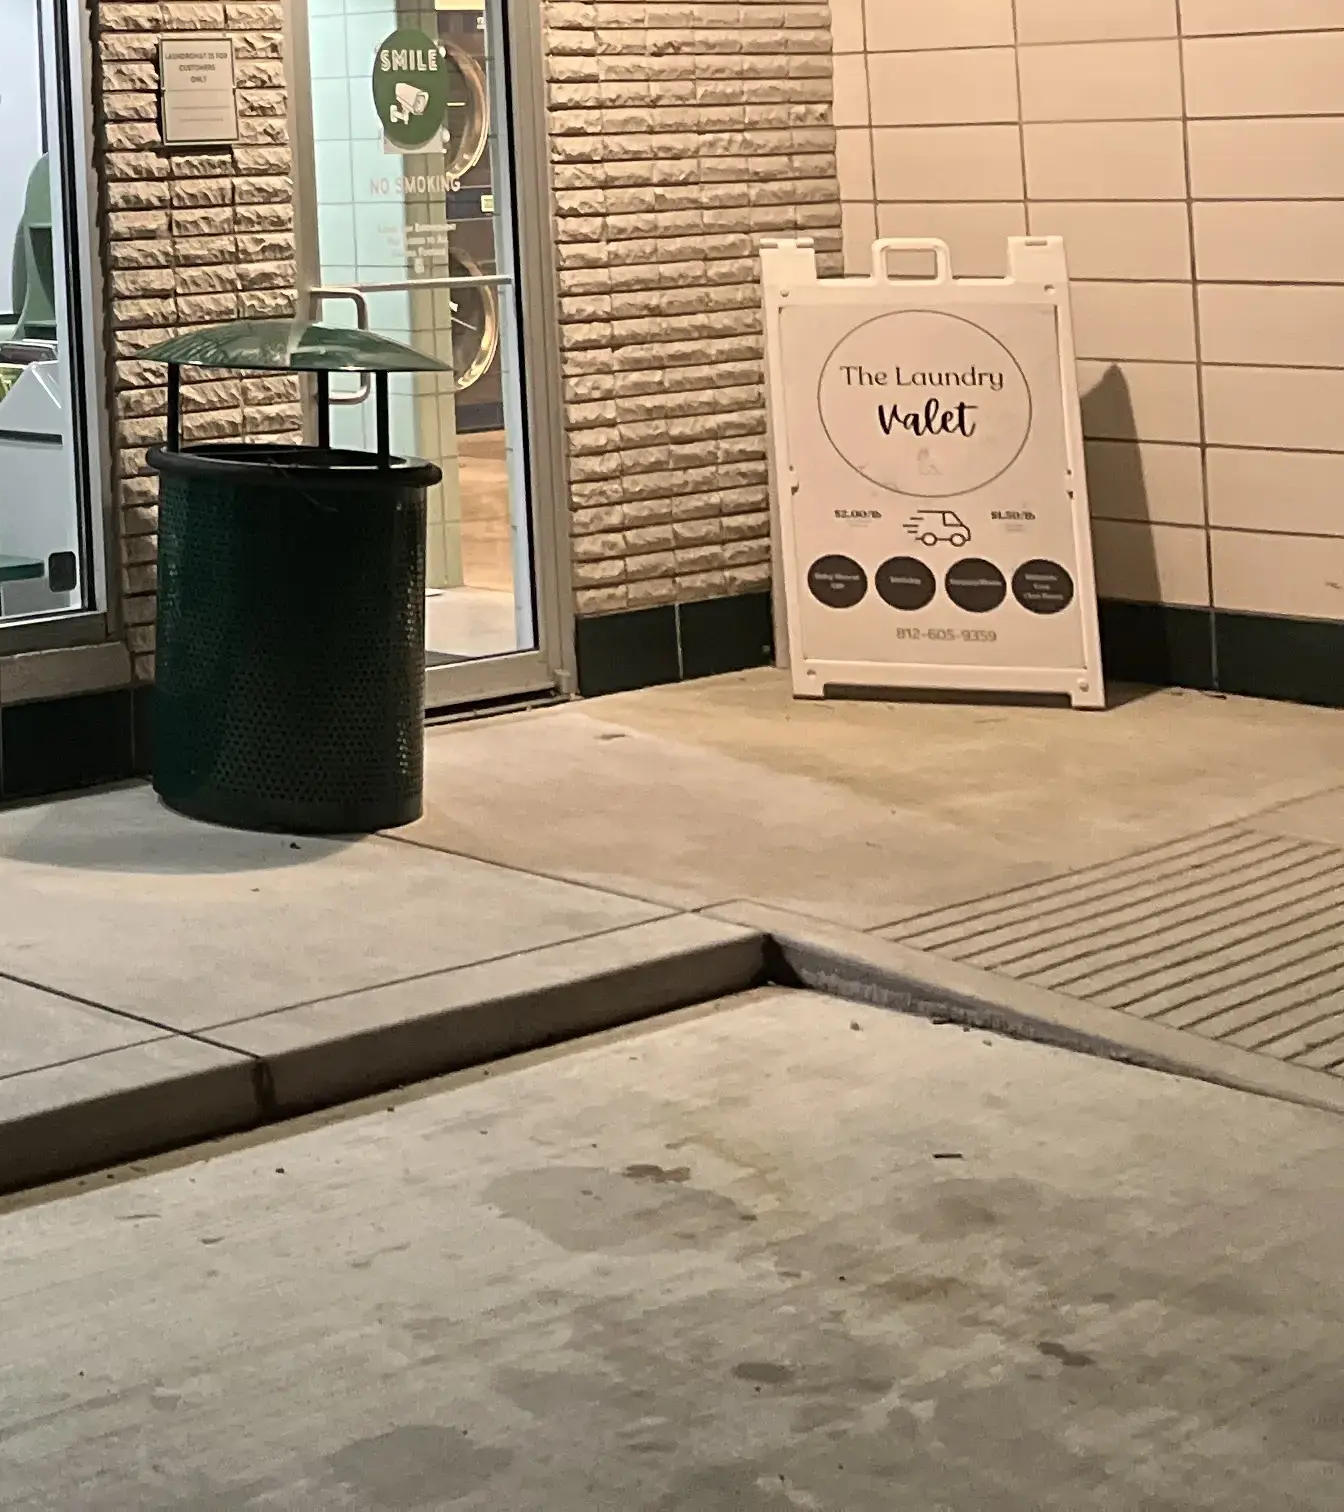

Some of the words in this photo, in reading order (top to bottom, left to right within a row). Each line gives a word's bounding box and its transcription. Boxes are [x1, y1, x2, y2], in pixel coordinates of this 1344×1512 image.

[379, 49, 438, 71] SMILE
[370, 178, 390, 194] NO
[396, 174, 461, 193] SMOKING
[840, 365, 888, 386] The
[895, 365, 1004, 391] Laundry
[878, 398, 979, 438] Valet
